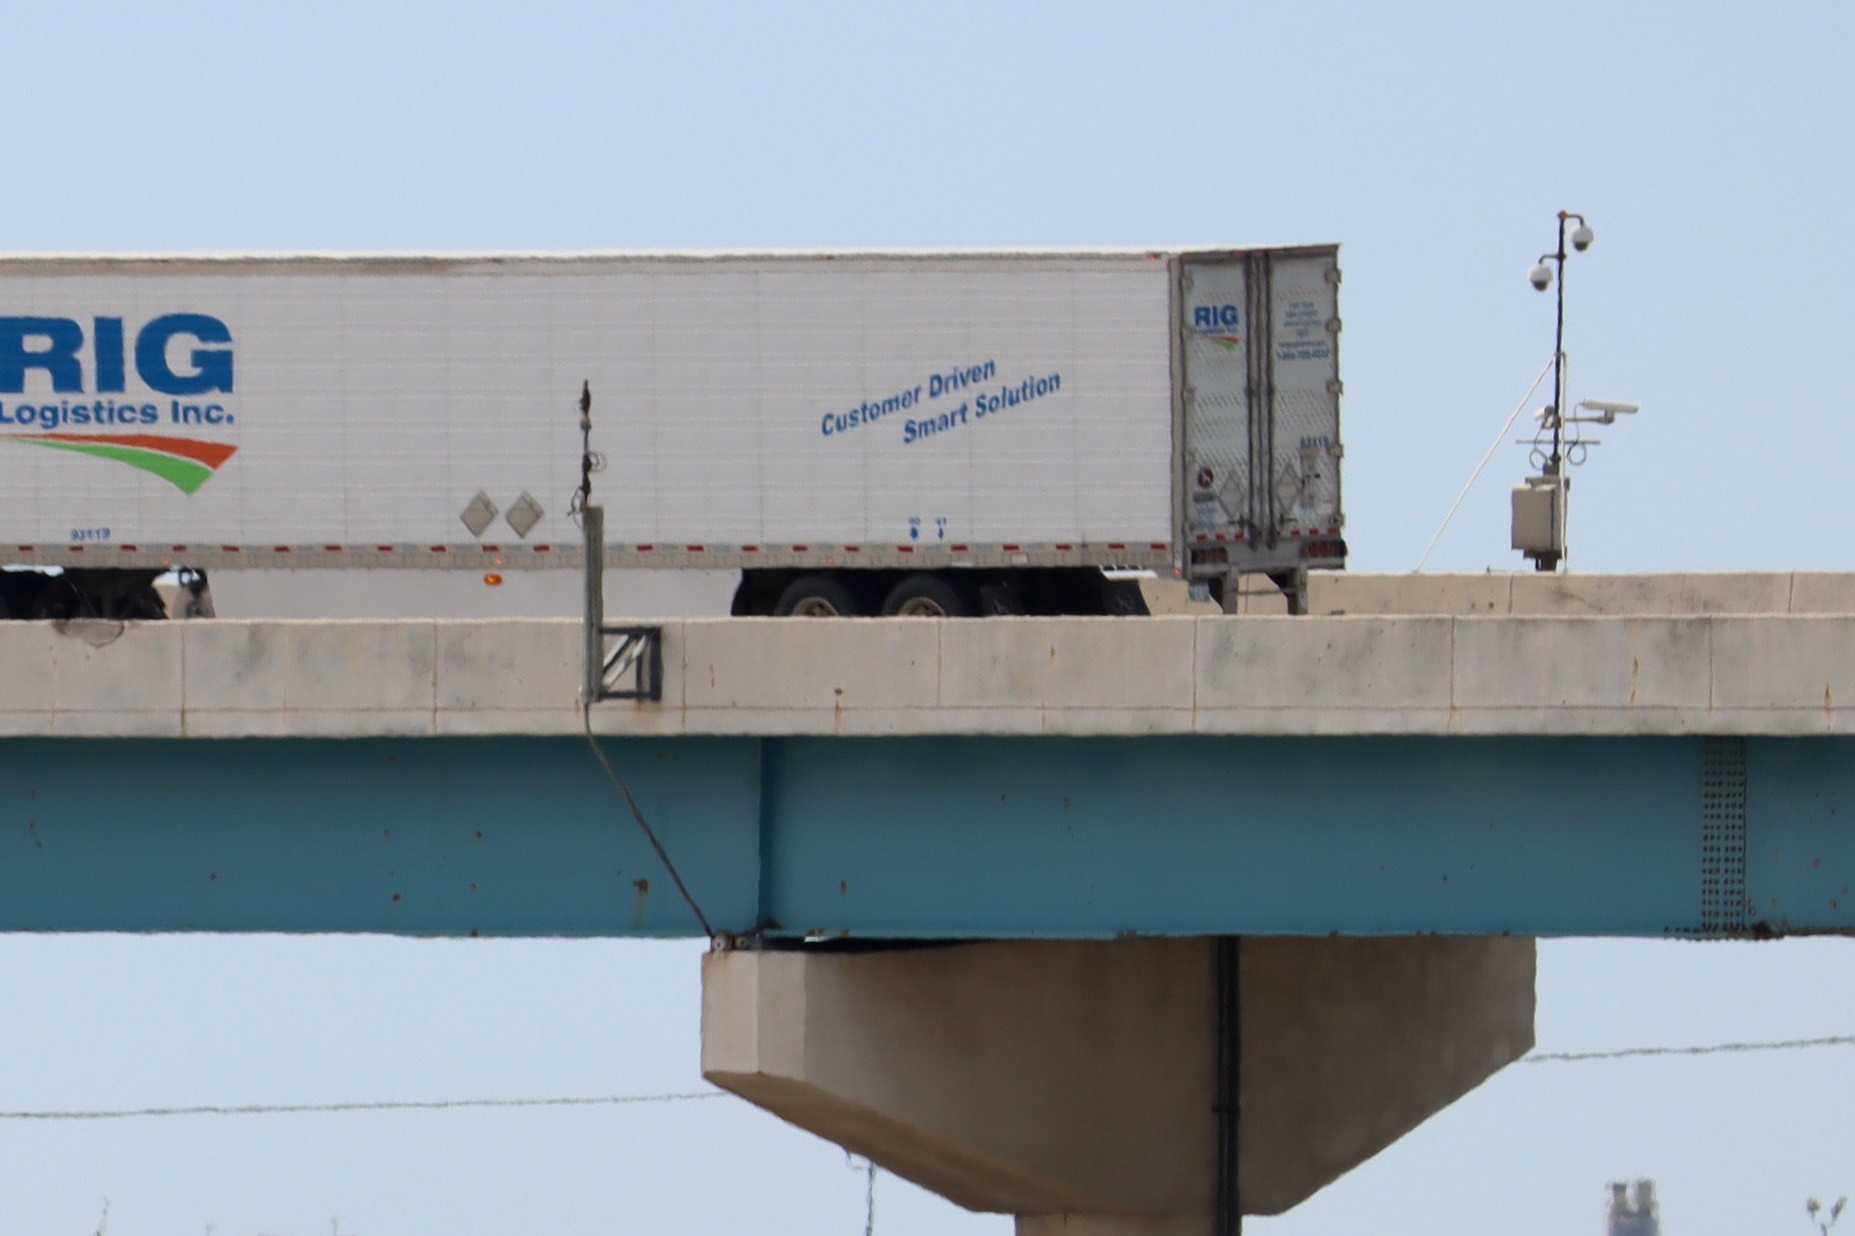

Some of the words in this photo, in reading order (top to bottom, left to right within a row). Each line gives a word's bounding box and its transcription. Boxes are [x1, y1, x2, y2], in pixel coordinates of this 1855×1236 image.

[1194, 304, 1239, 327] RIG
[171, 400, 235, 424] Inc.
[821, 384, 921, 437] Customer
[928, 359, 995, 399] Driven
[903, 402, 968, 444] Smart
[975, 372, 1061, 419] Solution
